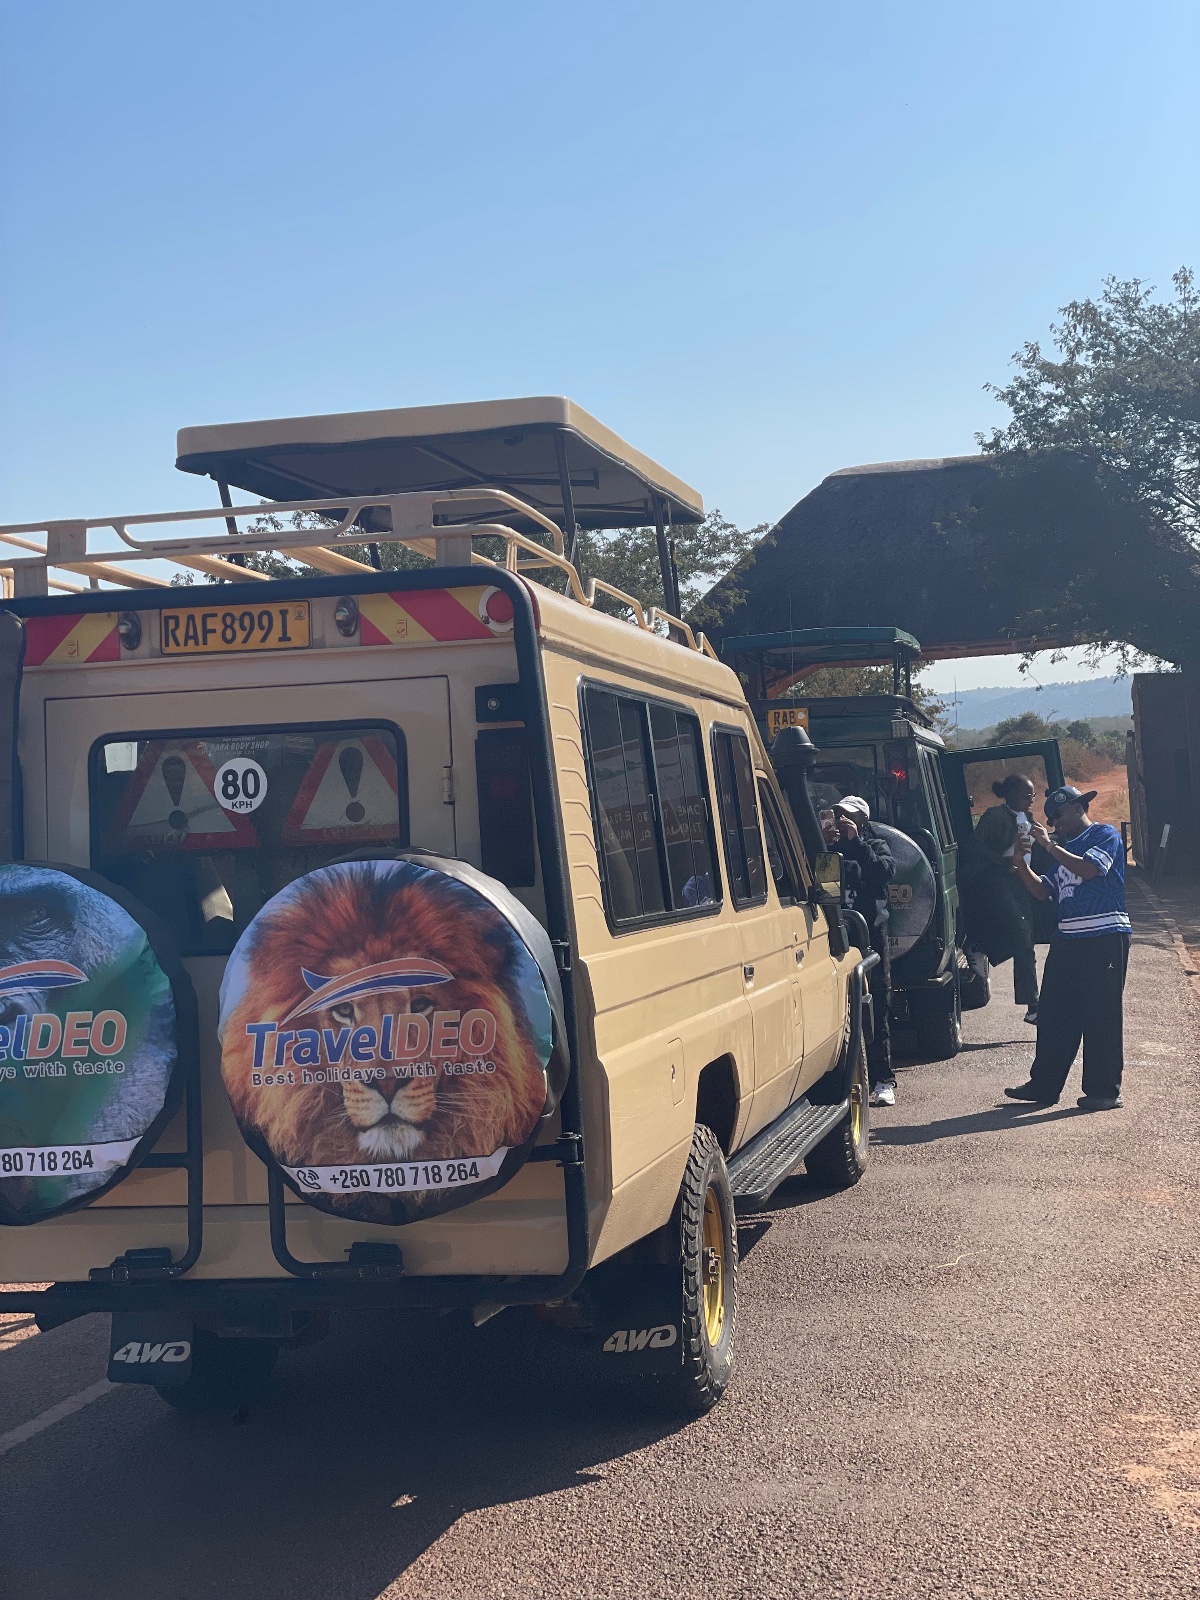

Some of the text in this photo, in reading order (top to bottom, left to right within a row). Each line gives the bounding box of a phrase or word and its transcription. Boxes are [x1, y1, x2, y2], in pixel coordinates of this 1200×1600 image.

[163, 609, 292, 648] RAF899I
[773, 711, 796, 725] RAB
[250, 740, 270, 750] SHOP
[222, 768, 260, 800] 80
[231, 800, 253, 809] KPH
[246, 1009, 497, 1068] TravelDEO
[23, 1061, 66, 1078] with
[73, 1059, 125, 1075] taste
[251, 1059, 497, 1087] Best holidays with taste
[26, 1151, 58, 1171] 718
[61, 1149, 94, 1170] 264
[330, 1161, 480, 1189] +250 780 718 264
[603, 1324, 677, 1352] 4WD
[113, 1341, 191, 1364] 4WD
